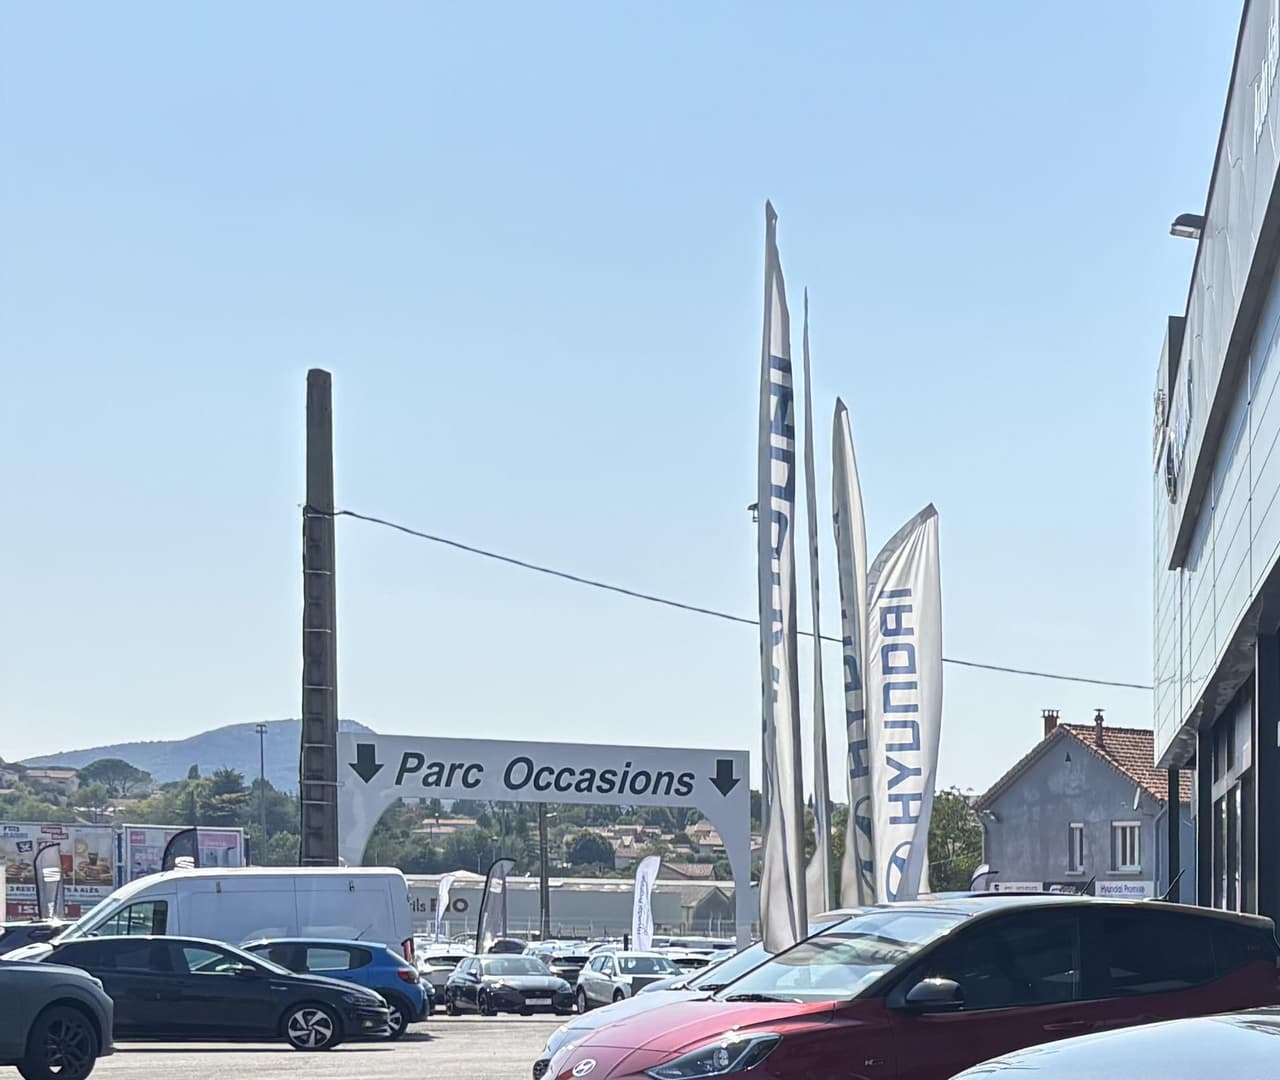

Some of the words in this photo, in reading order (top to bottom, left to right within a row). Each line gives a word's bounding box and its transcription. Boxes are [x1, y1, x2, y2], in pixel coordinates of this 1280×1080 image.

[394, 752, 485, 789] Parc
[503, 756, 696, 797] Occasions
[879, 586, 923, 826] HYUNDAI
